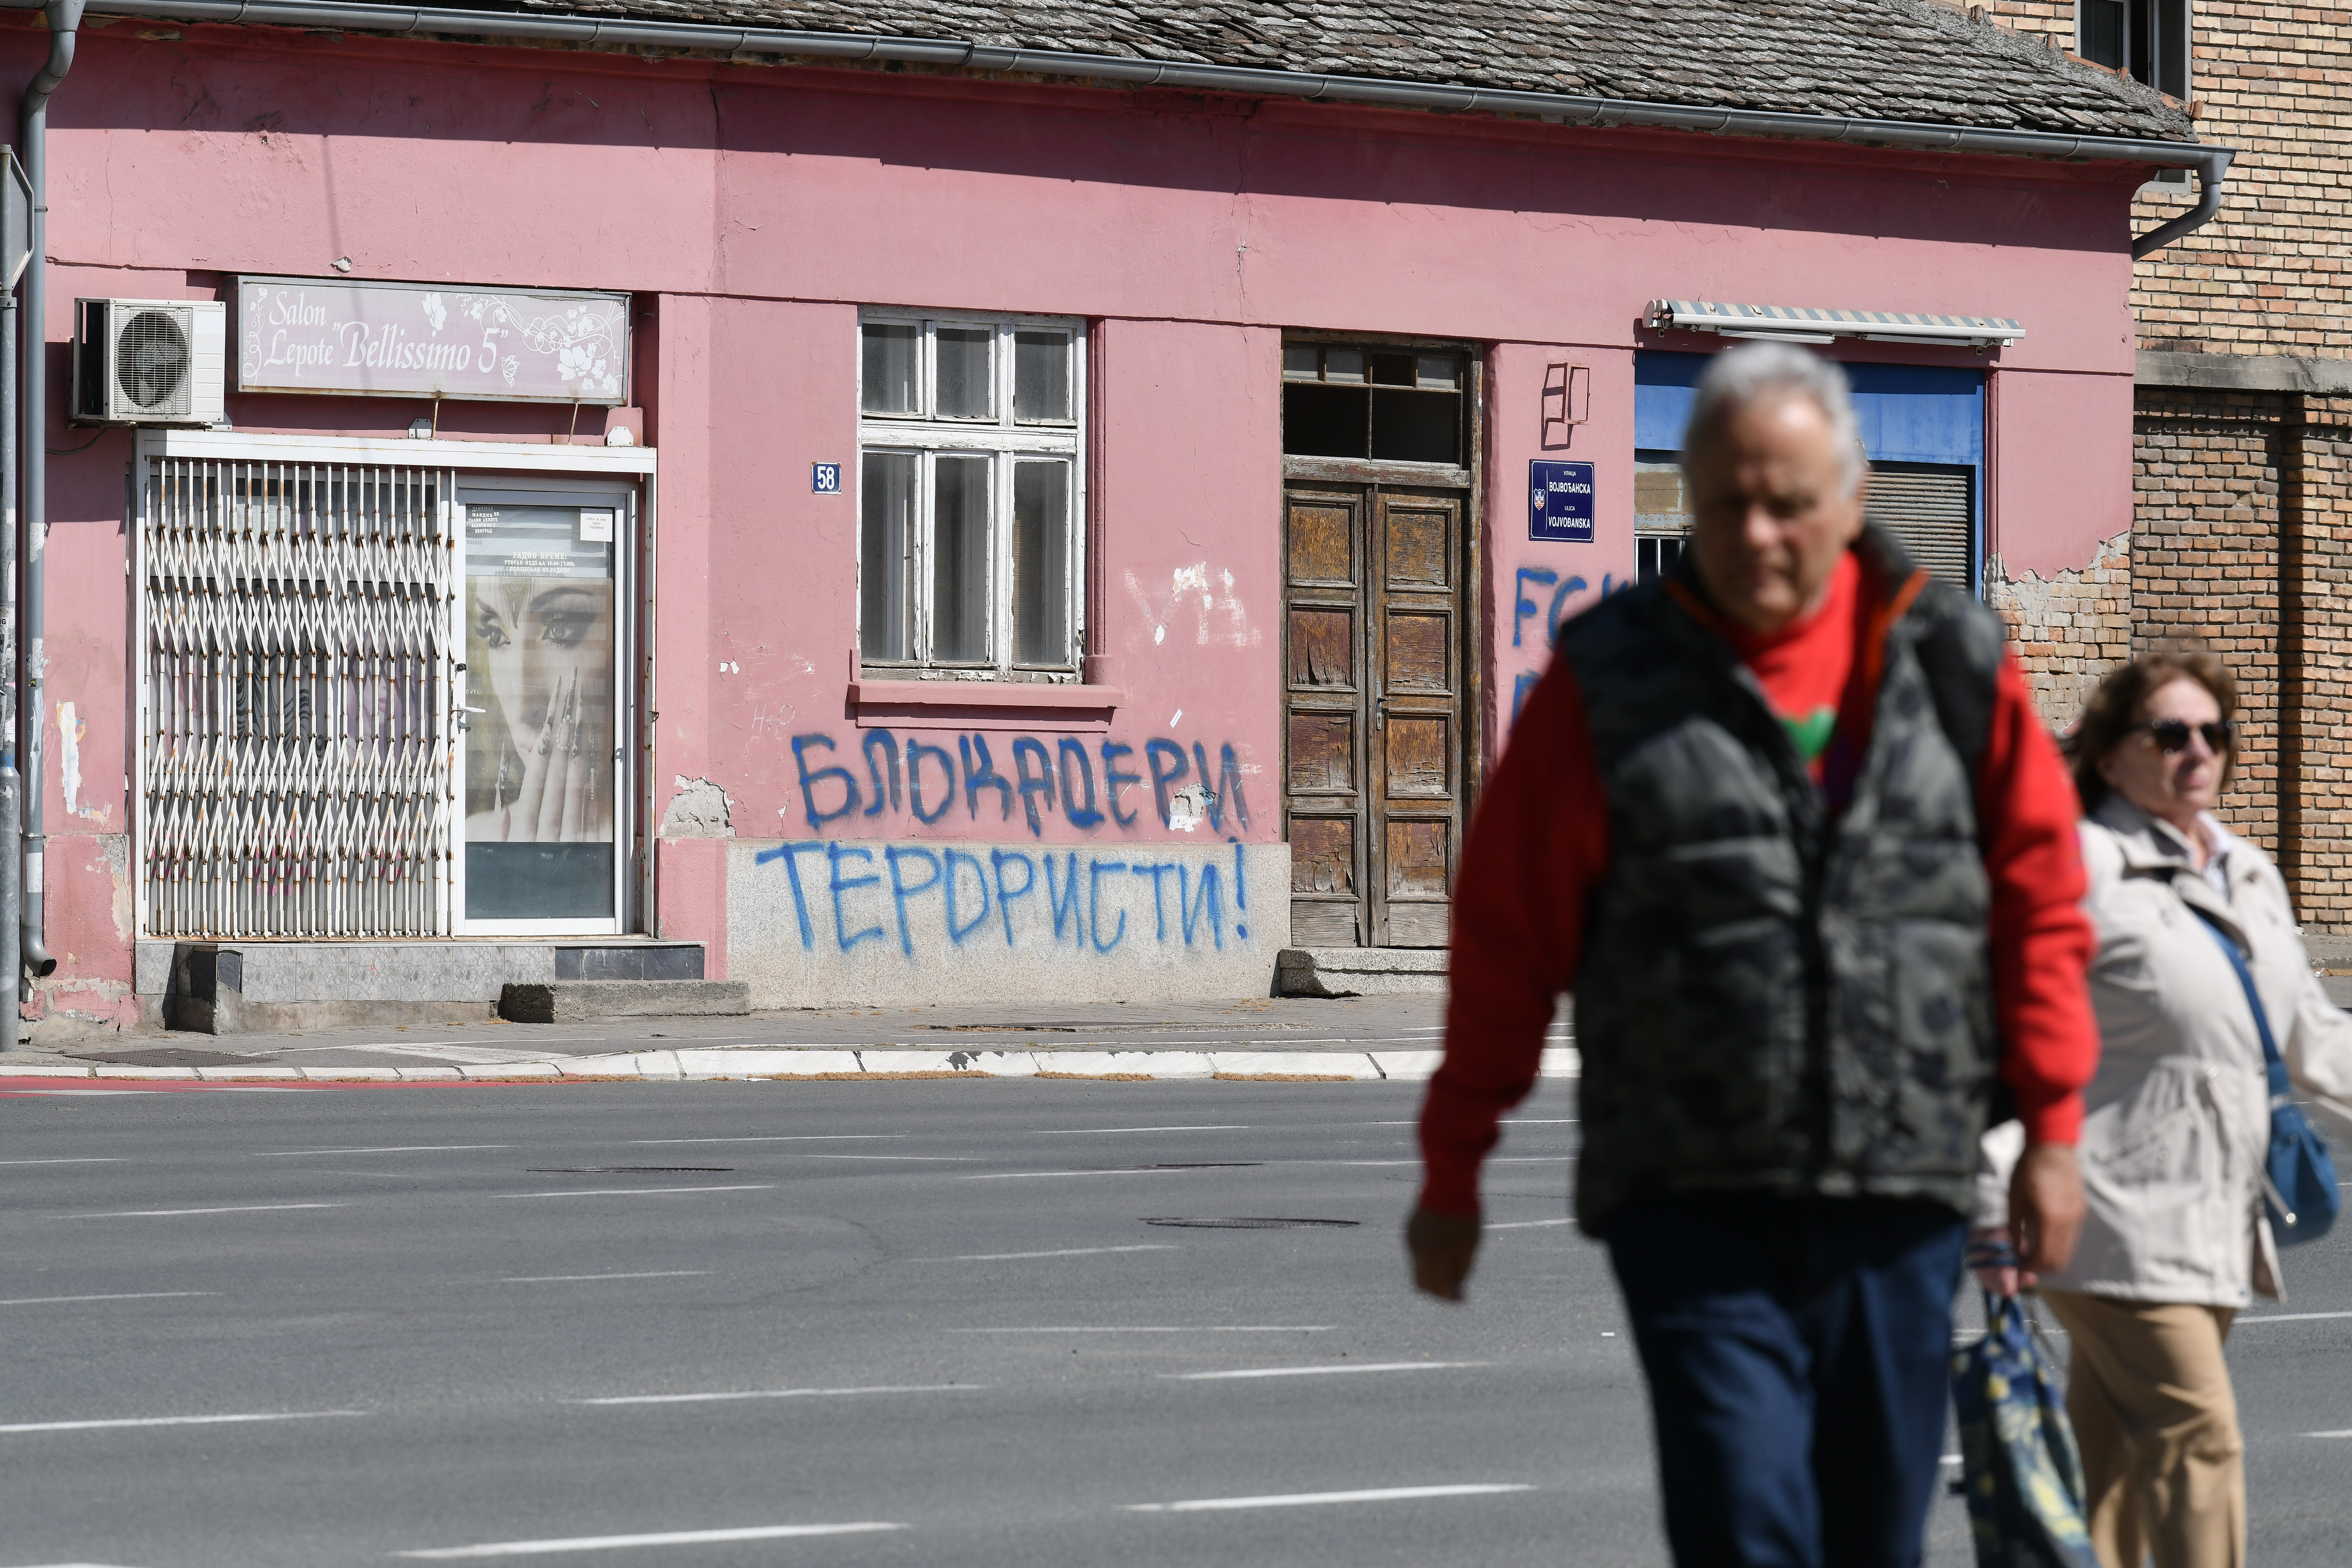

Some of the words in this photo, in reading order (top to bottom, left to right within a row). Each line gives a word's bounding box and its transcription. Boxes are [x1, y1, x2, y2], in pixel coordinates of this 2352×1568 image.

[269, 291, 326, 326] Salon
[264, 329, 334, 377] Lepote
[817, 466, 835, 490] 58
[1549, 481, 1591, 494] ВОЈВОЂАНСКА
[1548, 516, 1590, 529] VOJVOĐANSKA
[513, 552, 537, 560] РАДНО
[791, 727, 1250, 836] БЛОКАДЕРИ
[756, 836, 1249, 956] ТЕРОРИСТИ!
